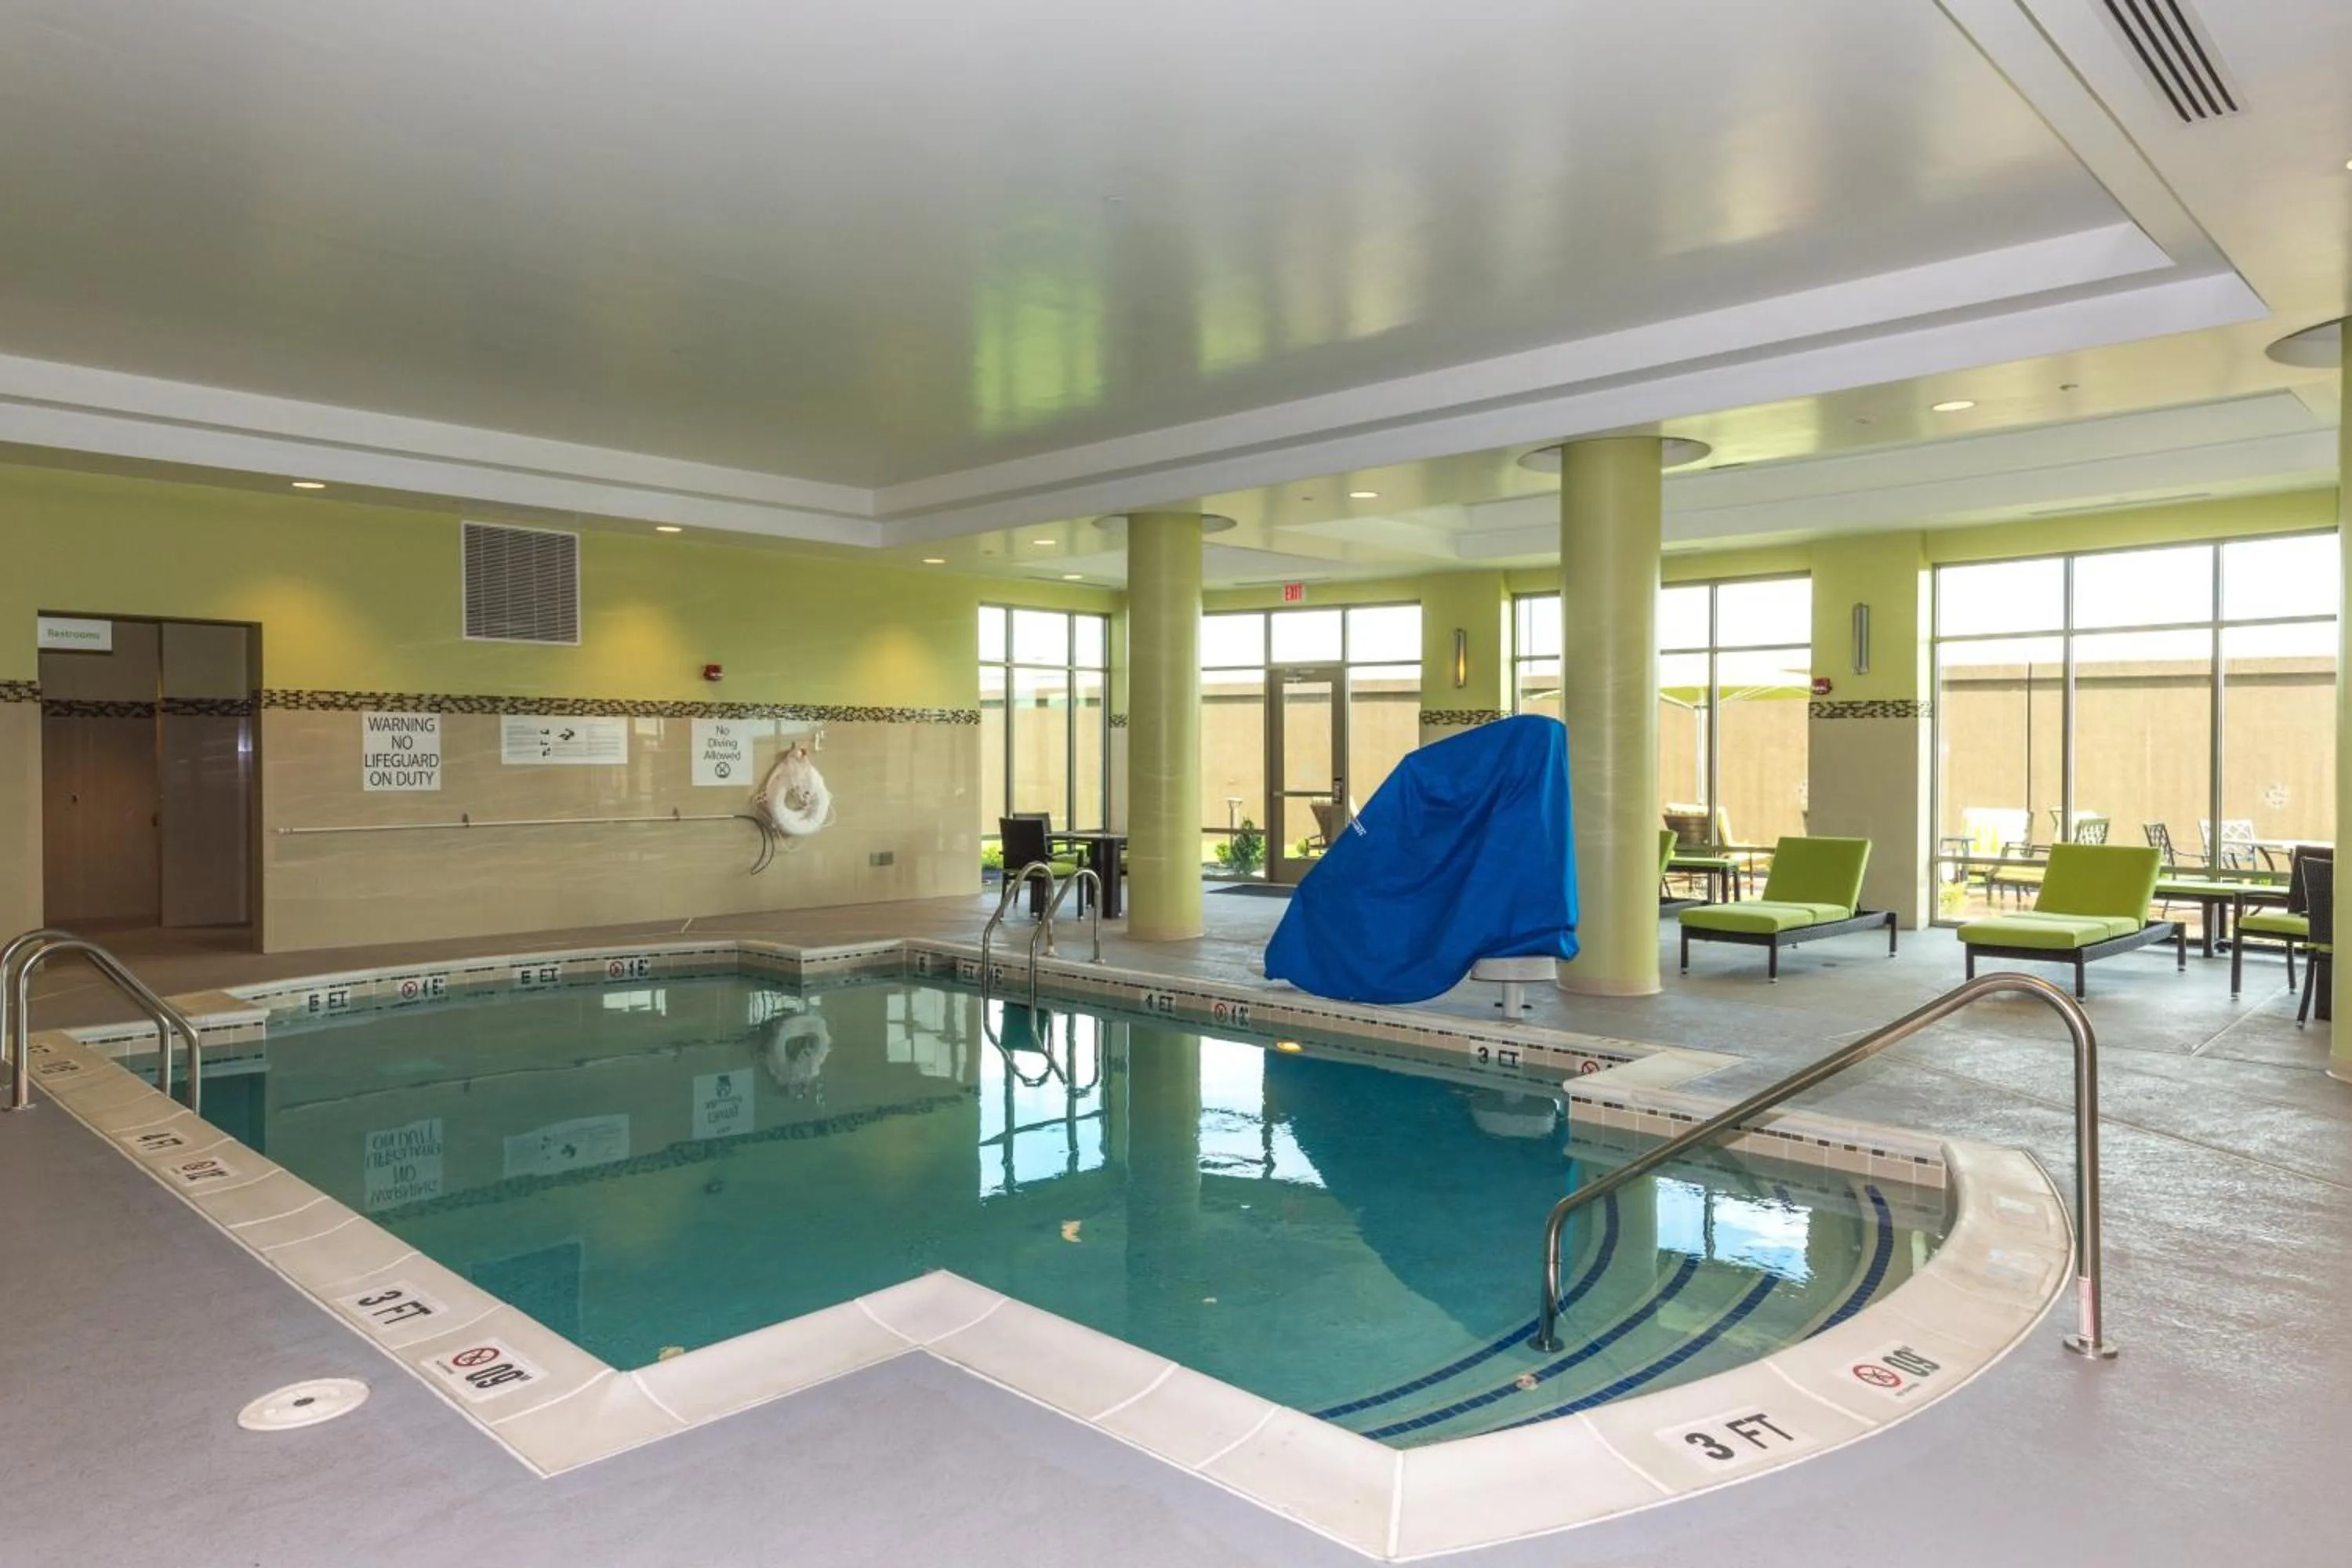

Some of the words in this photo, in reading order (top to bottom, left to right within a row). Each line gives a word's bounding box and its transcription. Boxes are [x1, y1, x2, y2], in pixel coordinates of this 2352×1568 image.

[1284, 584, 1302, 601] EXIT
[48, 628, 100, 641] Restrooms
[368, 716, 436, 732] WARNING
[716, 725, 730, 735] No
[391, 735, 413, 750] NO
[708, 738, 739, 750] Diving
[365, 753, 440, 768] LIFEGUARD
[703, 750, 742, 761] Allowed
[369, 771, 392, 786] ON
[396, 771, 435, 786] DUTY
[358, 1290, 402, 1306] 3
[372, 1301, 432, 1324] FT
[1685, 1432, 1734, 1461] 3
[1725, 1414, 1794, 1450] FT
